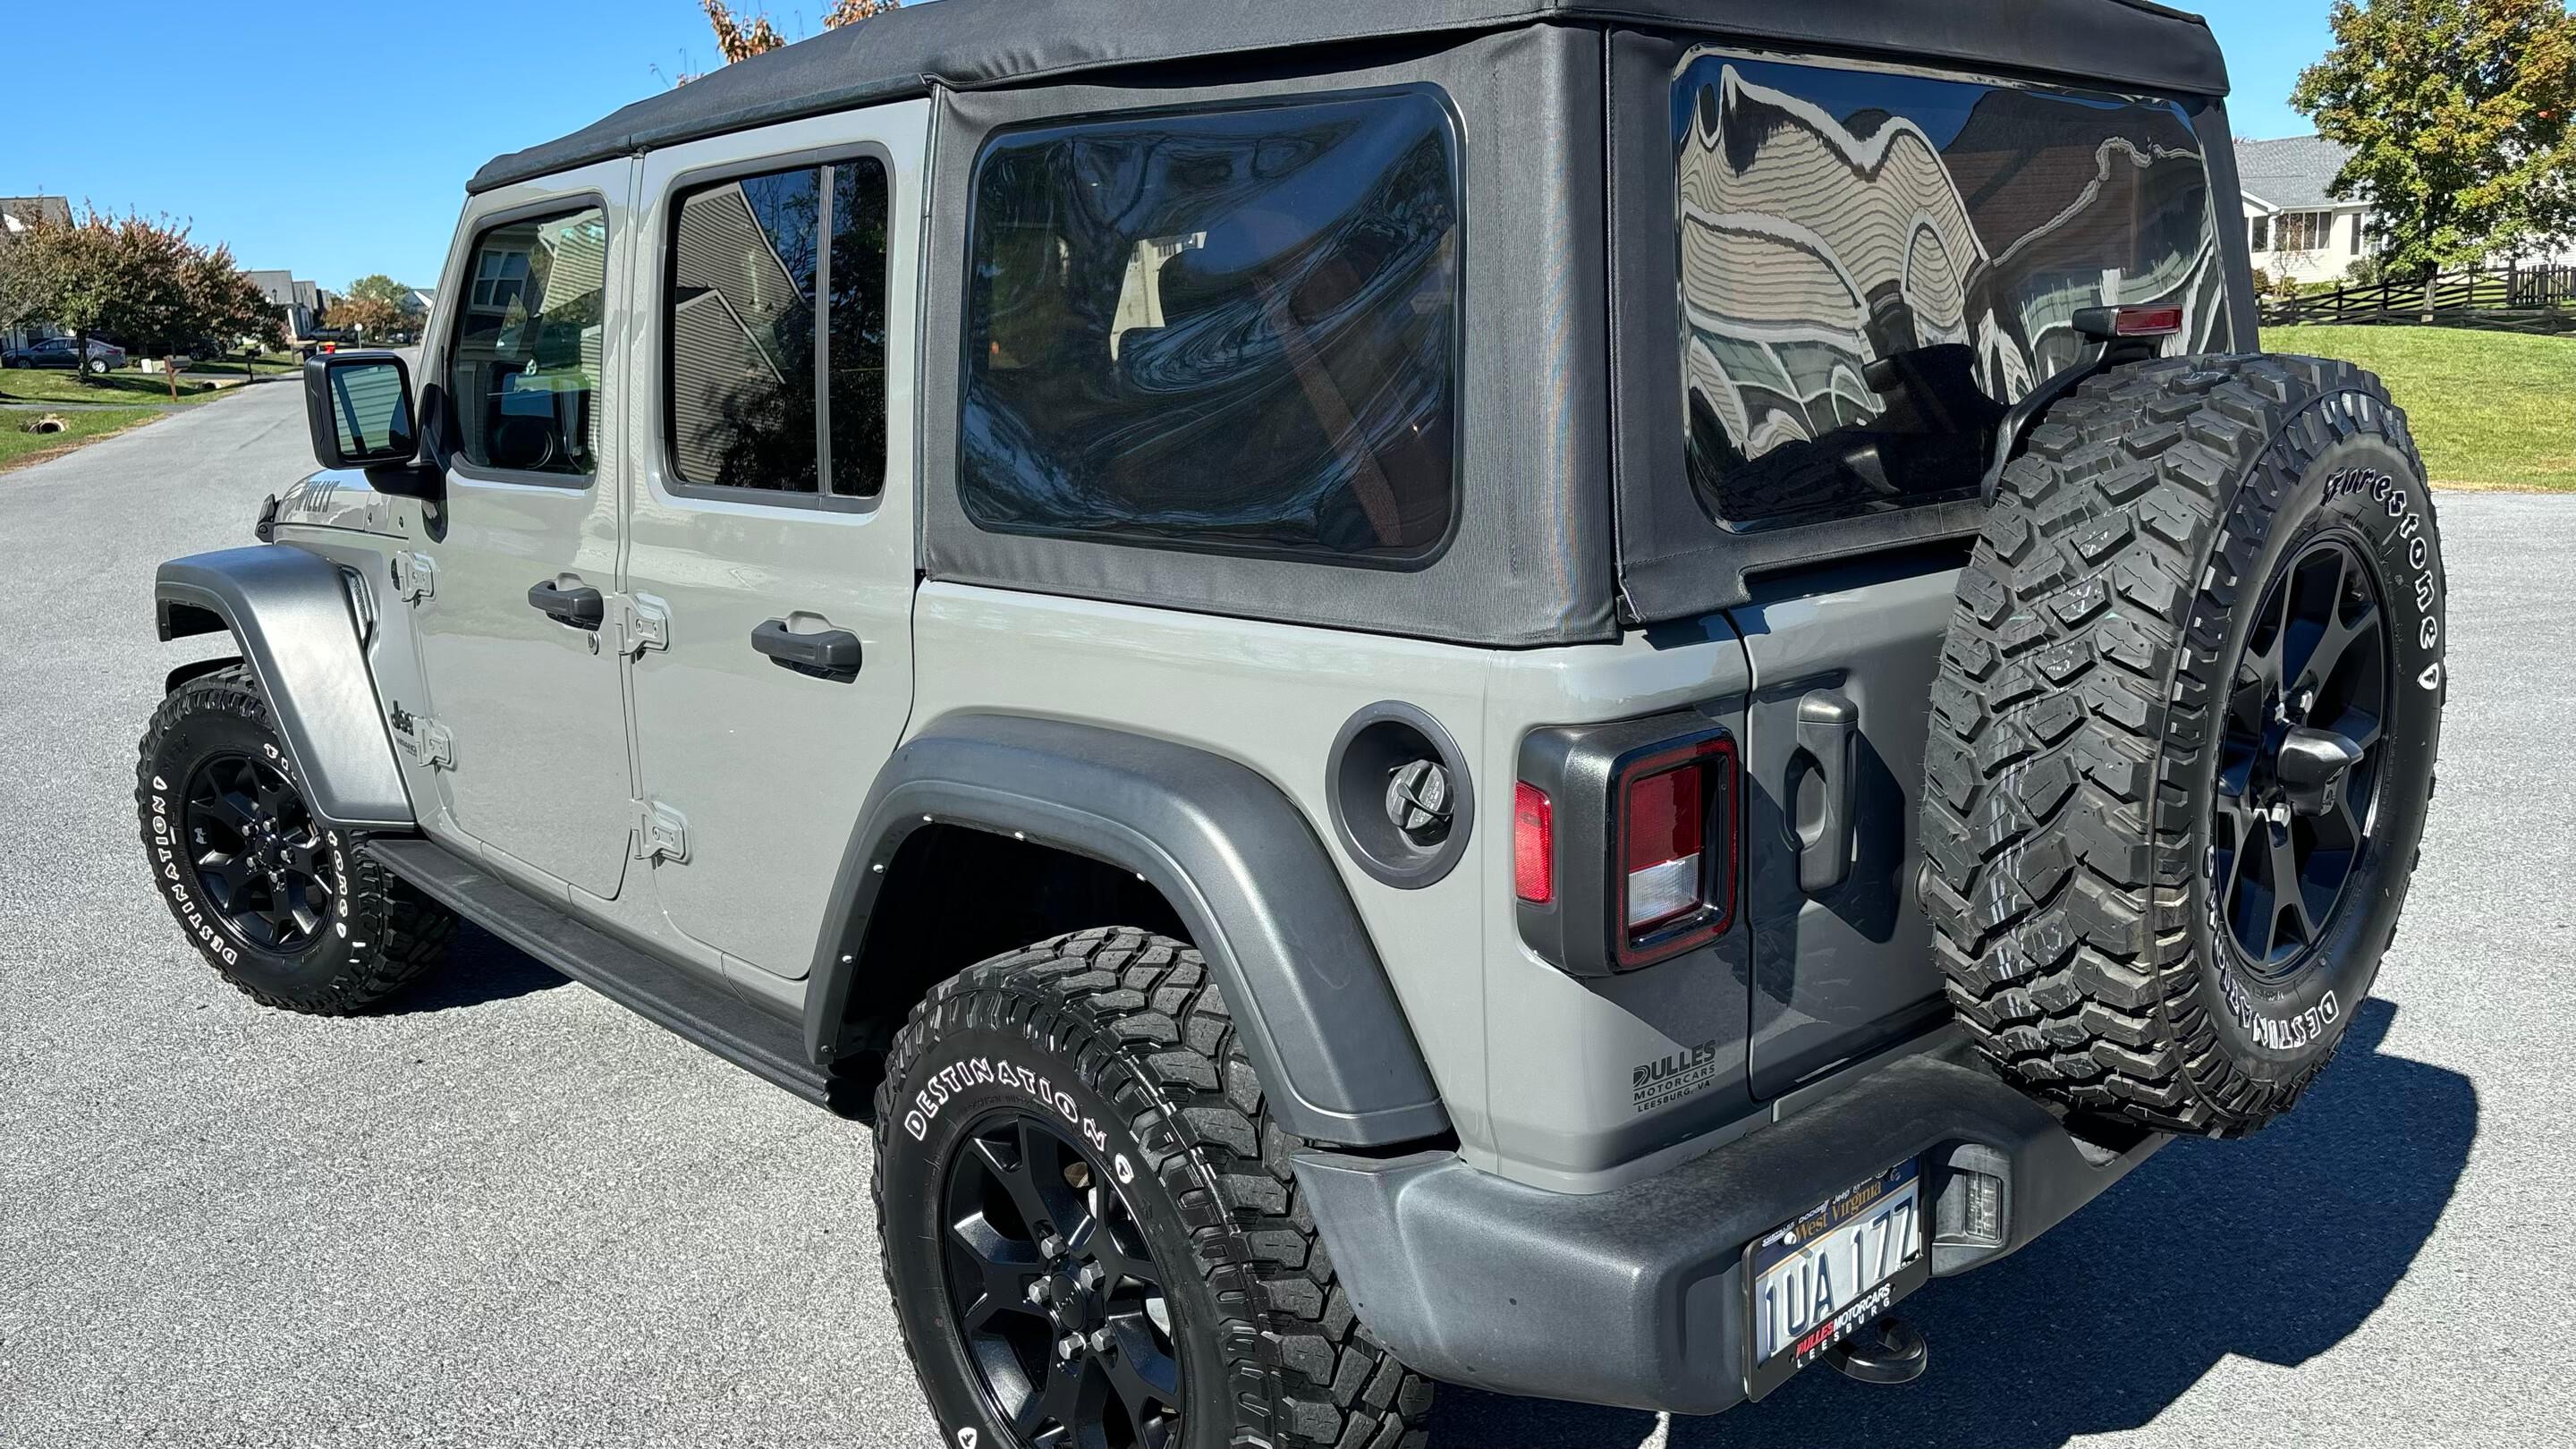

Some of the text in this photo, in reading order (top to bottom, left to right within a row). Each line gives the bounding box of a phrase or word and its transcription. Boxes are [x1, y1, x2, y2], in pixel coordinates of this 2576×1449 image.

[152, 795, 238, 965] DESTINATION
[1633, 1039, 1716, 1088] DULLES
[1633, 1064, 1715, 1101] MOTORCARS
[1698, 1080, 1710, 1090] VA
[904, 1056, 1107, 1152] DESTINATION
[1794, 1180, 1881, 1244] West Virginia
[1766, 1196, 1913, 1353] 1UA 177
